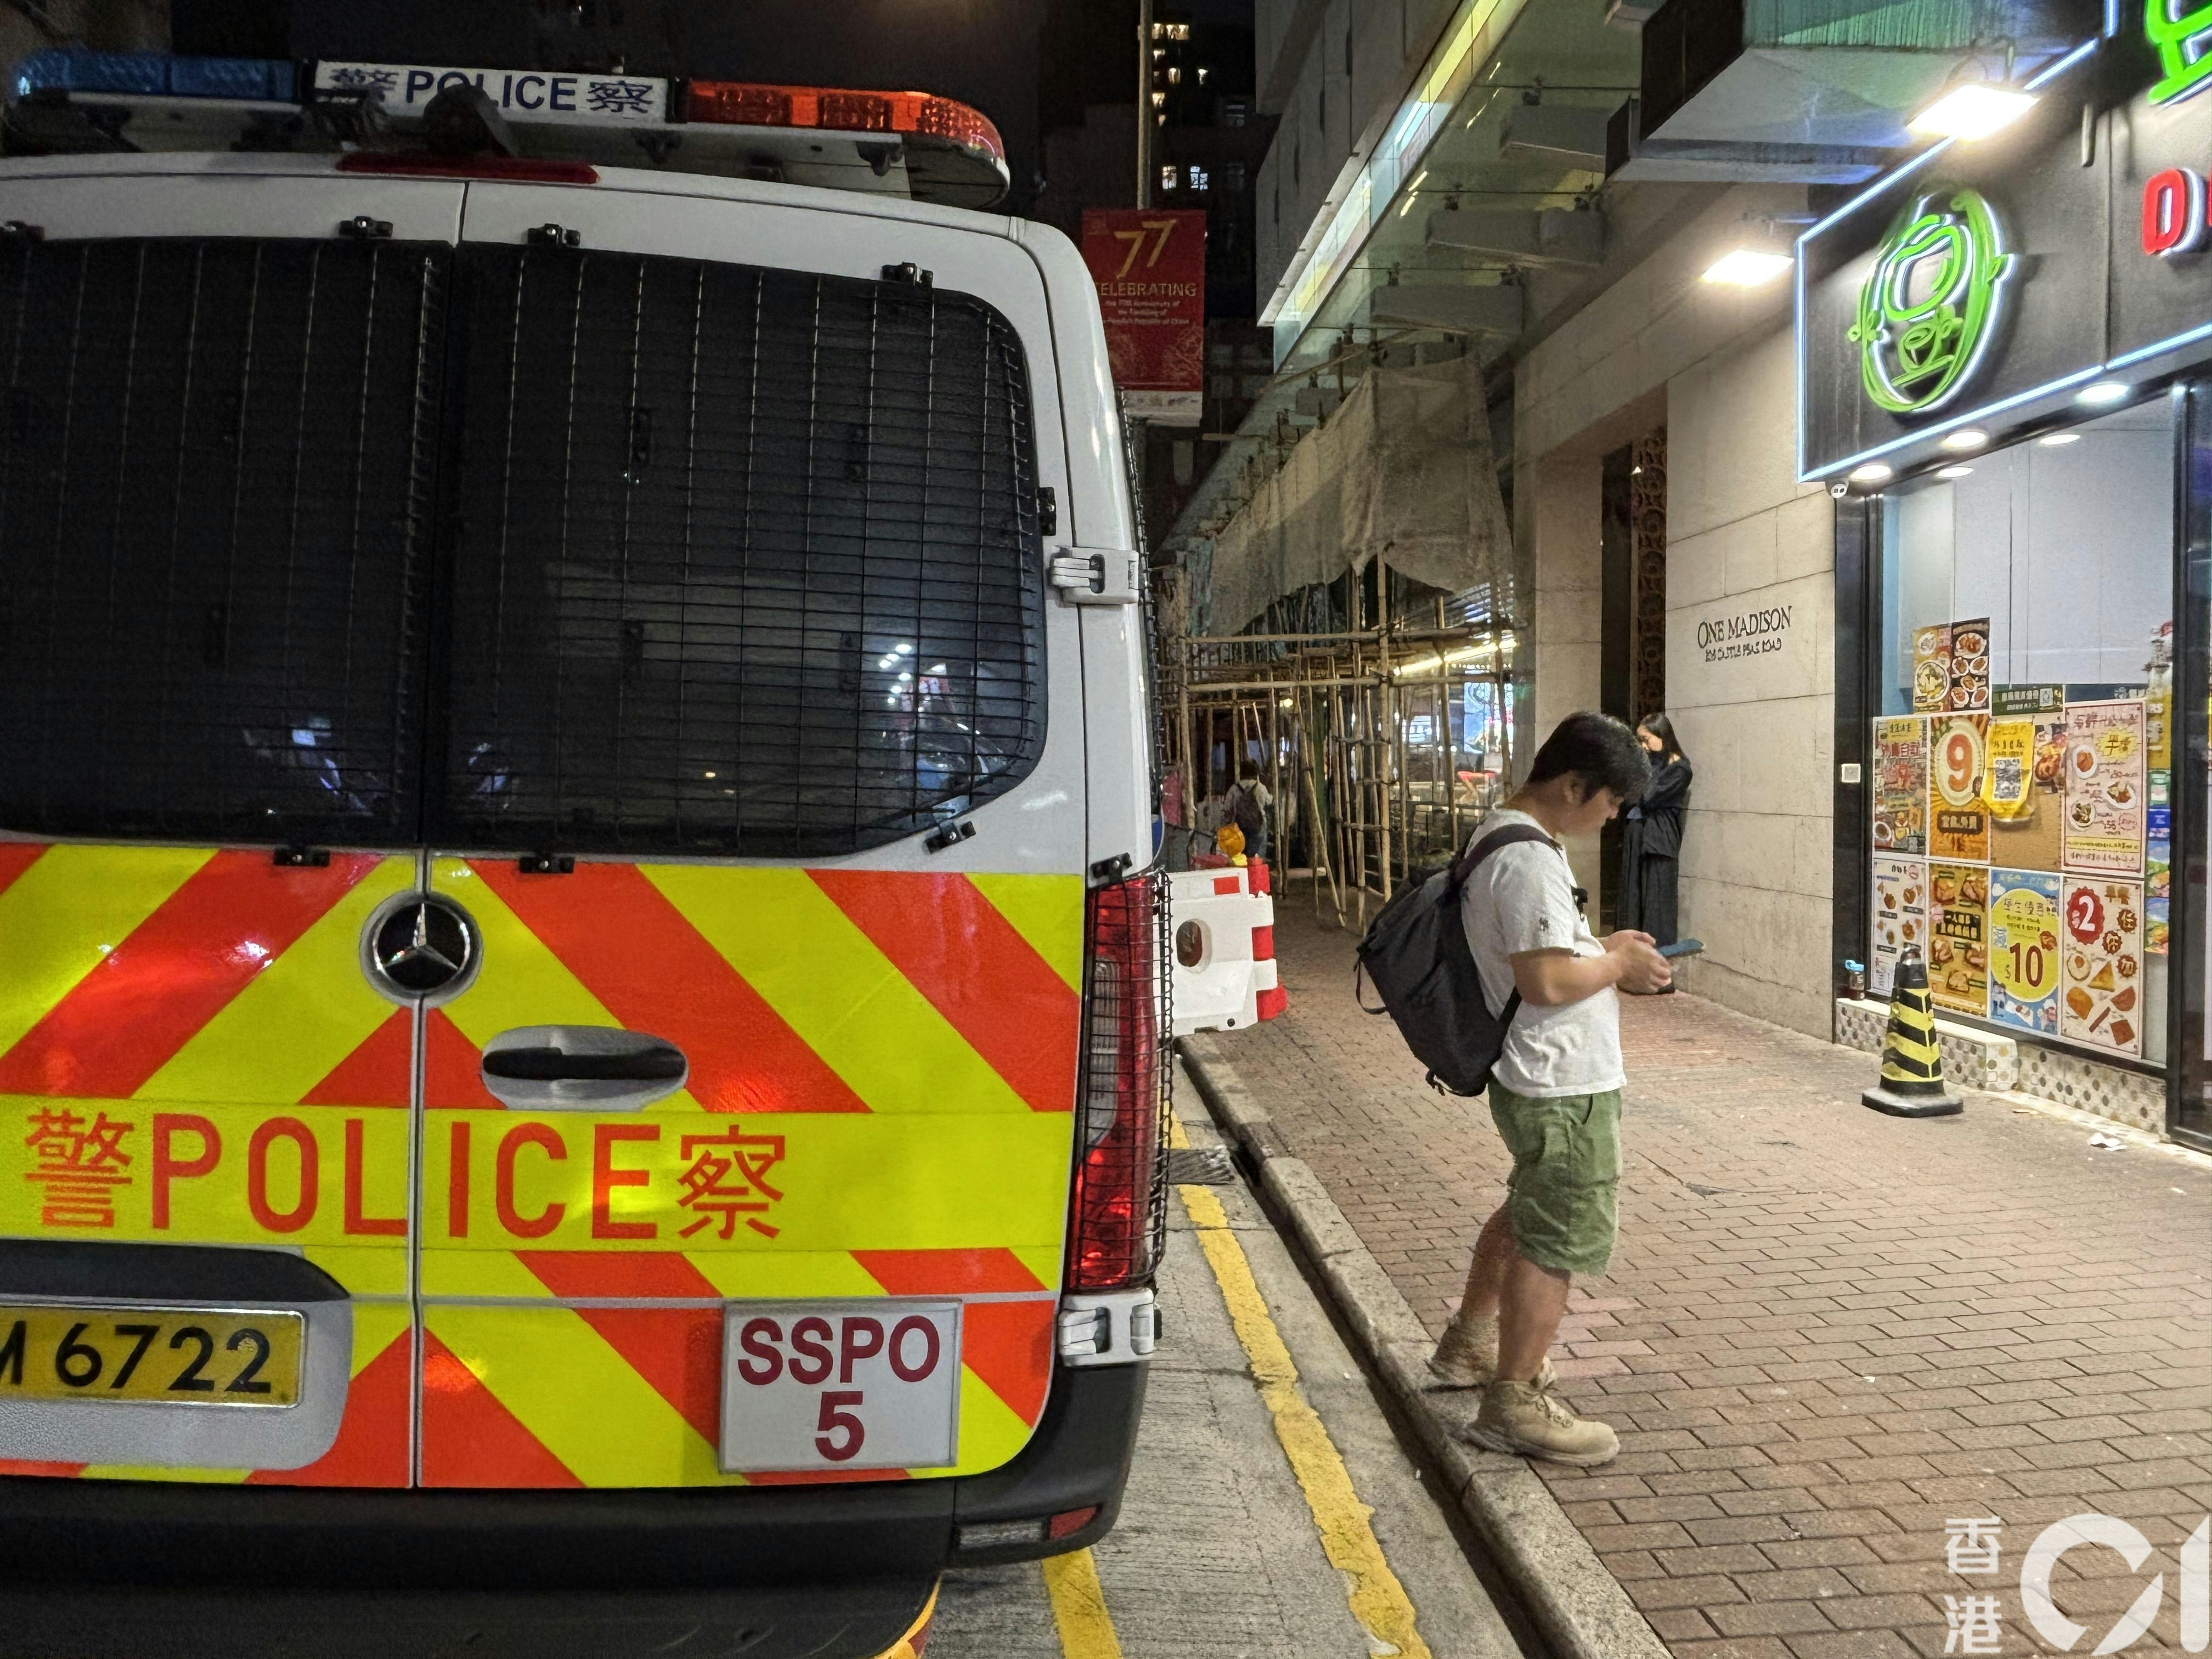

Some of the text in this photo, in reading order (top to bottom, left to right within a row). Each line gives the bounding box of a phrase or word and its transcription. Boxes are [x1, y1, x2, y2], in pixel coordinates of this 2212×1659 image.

[406, 70, 578, 111] PICE
[586, 80, 654, 114] 察
[1114, 218, 1178, 280] 77
[1095, 283, 1197, 297] ELEBRATING
[1697, 605, 1792, 648] ONE MADISON
[1946, 733, 1973, 792] 9
[25, 1108, 786, 1241] 警 POLICE 察
[55, 1322, 272, 1394] 6722
[737, 1315, 940, 1386] SSPO
[815, 1391, 865, 1462] 5
